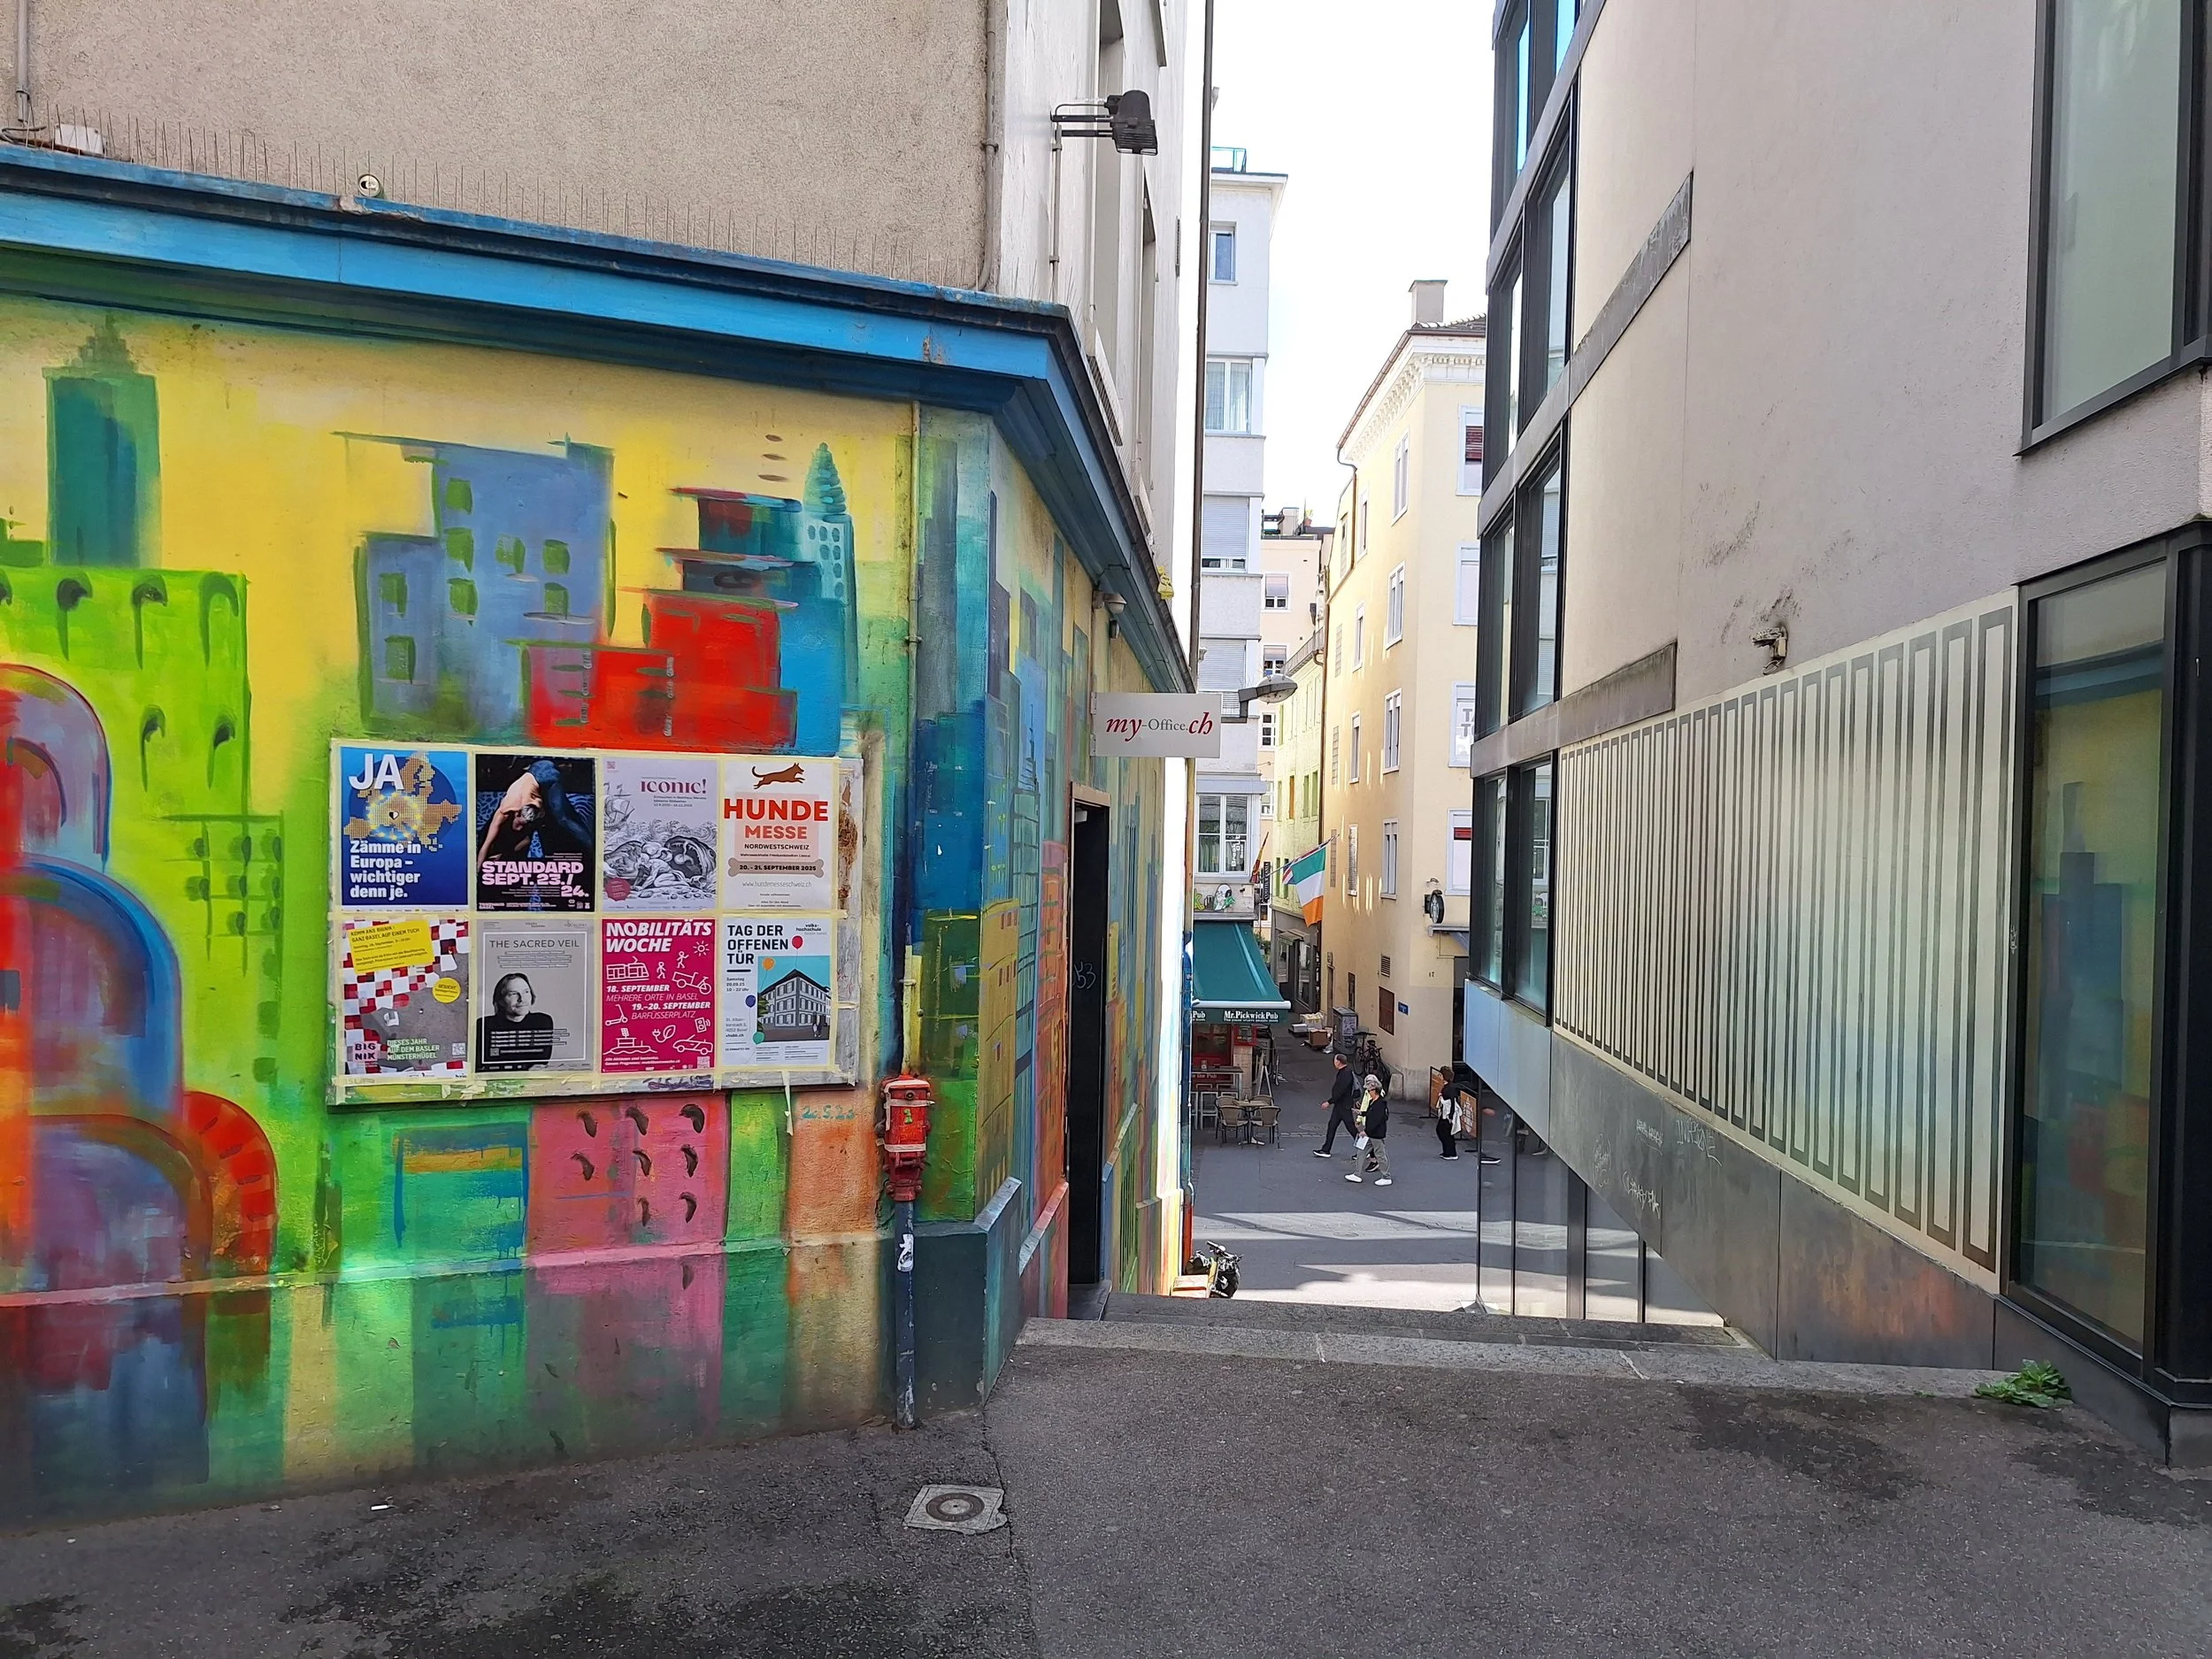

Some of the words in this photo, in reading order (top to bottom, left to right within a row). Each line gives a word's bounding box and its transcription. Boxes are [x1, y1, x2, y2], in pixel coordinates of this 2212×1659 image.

[1106, 711, 1213, 741] my-Office.ch
[349, 753, 404, 790] JA
[724, 798, 828, 821] HUNDE
[745, 825, 807, 840] MESSE
[350, 841, 405, 855] Zämme
[407, 841, 421, 854] in
[350, 856, 403, 872] Europa
[481, 861, 584, 874] STANDARD
[349, 871, 420, 886] wichtiger
[481, 873, 534, 886] SEPT.
[349, 886, 388, 898] denn
[388, 886, 408, 901] je.
[561, 886, 589, 897] 24.
[606, 918, 712, 937] MOBILITÄTS
[726, 925, 752, 937] TAG
[757, 925, 783, 936] DER
[606, 938, 672, 953] WOCHE
[727, 939, 788, 950] OFFENEN
[726, 949, 755, 964] TÜR
[606, 993, 642, 1002] MEHRERE
[644, 993, 664, 1002] ORTE
[631, 1010, 696, 1019] BARFÜSSERPLATZ
[387, 1051, 437, 1061] MÜNSTERHÜGEL
